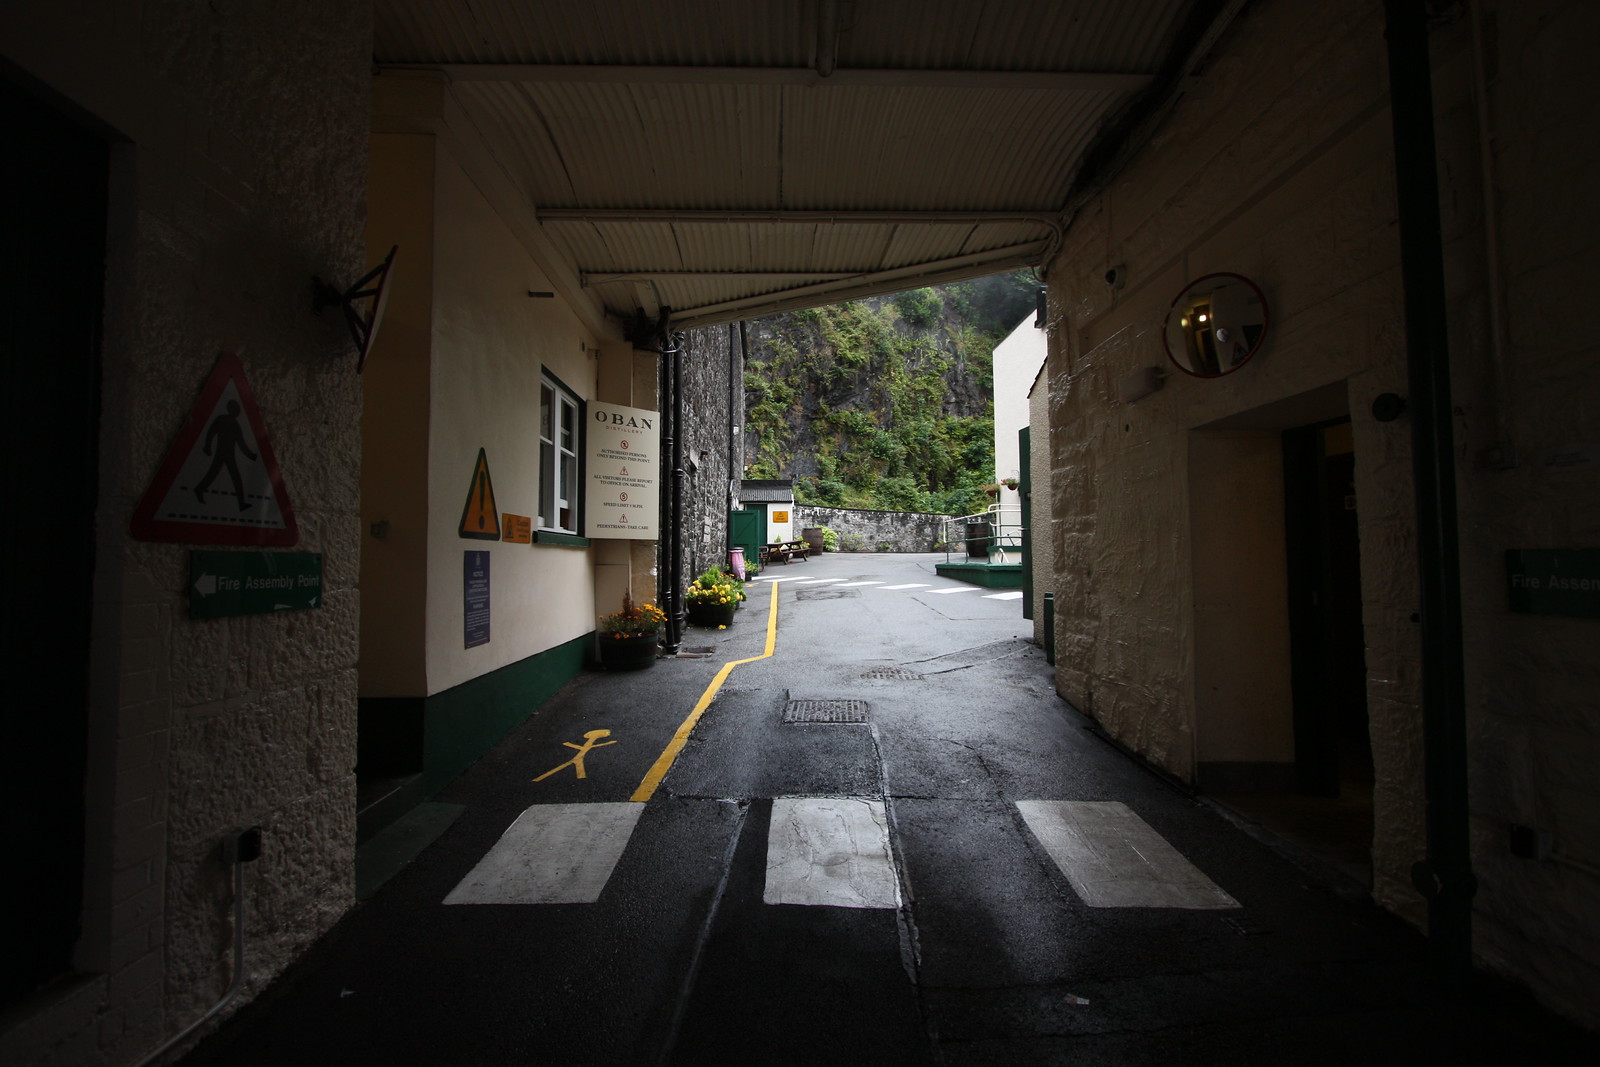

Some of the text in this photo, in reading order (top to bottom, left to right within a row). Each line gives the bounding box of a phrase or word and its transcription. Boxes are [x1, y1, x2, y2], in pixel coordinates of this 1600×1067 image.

[595, 411, 653, 430] OBAN
[605, 425, 643, 434] DISTILLERY
[218, 574, 319, 591] Fire Assembly Point
[1512, 573, 1541, 589] Fire
